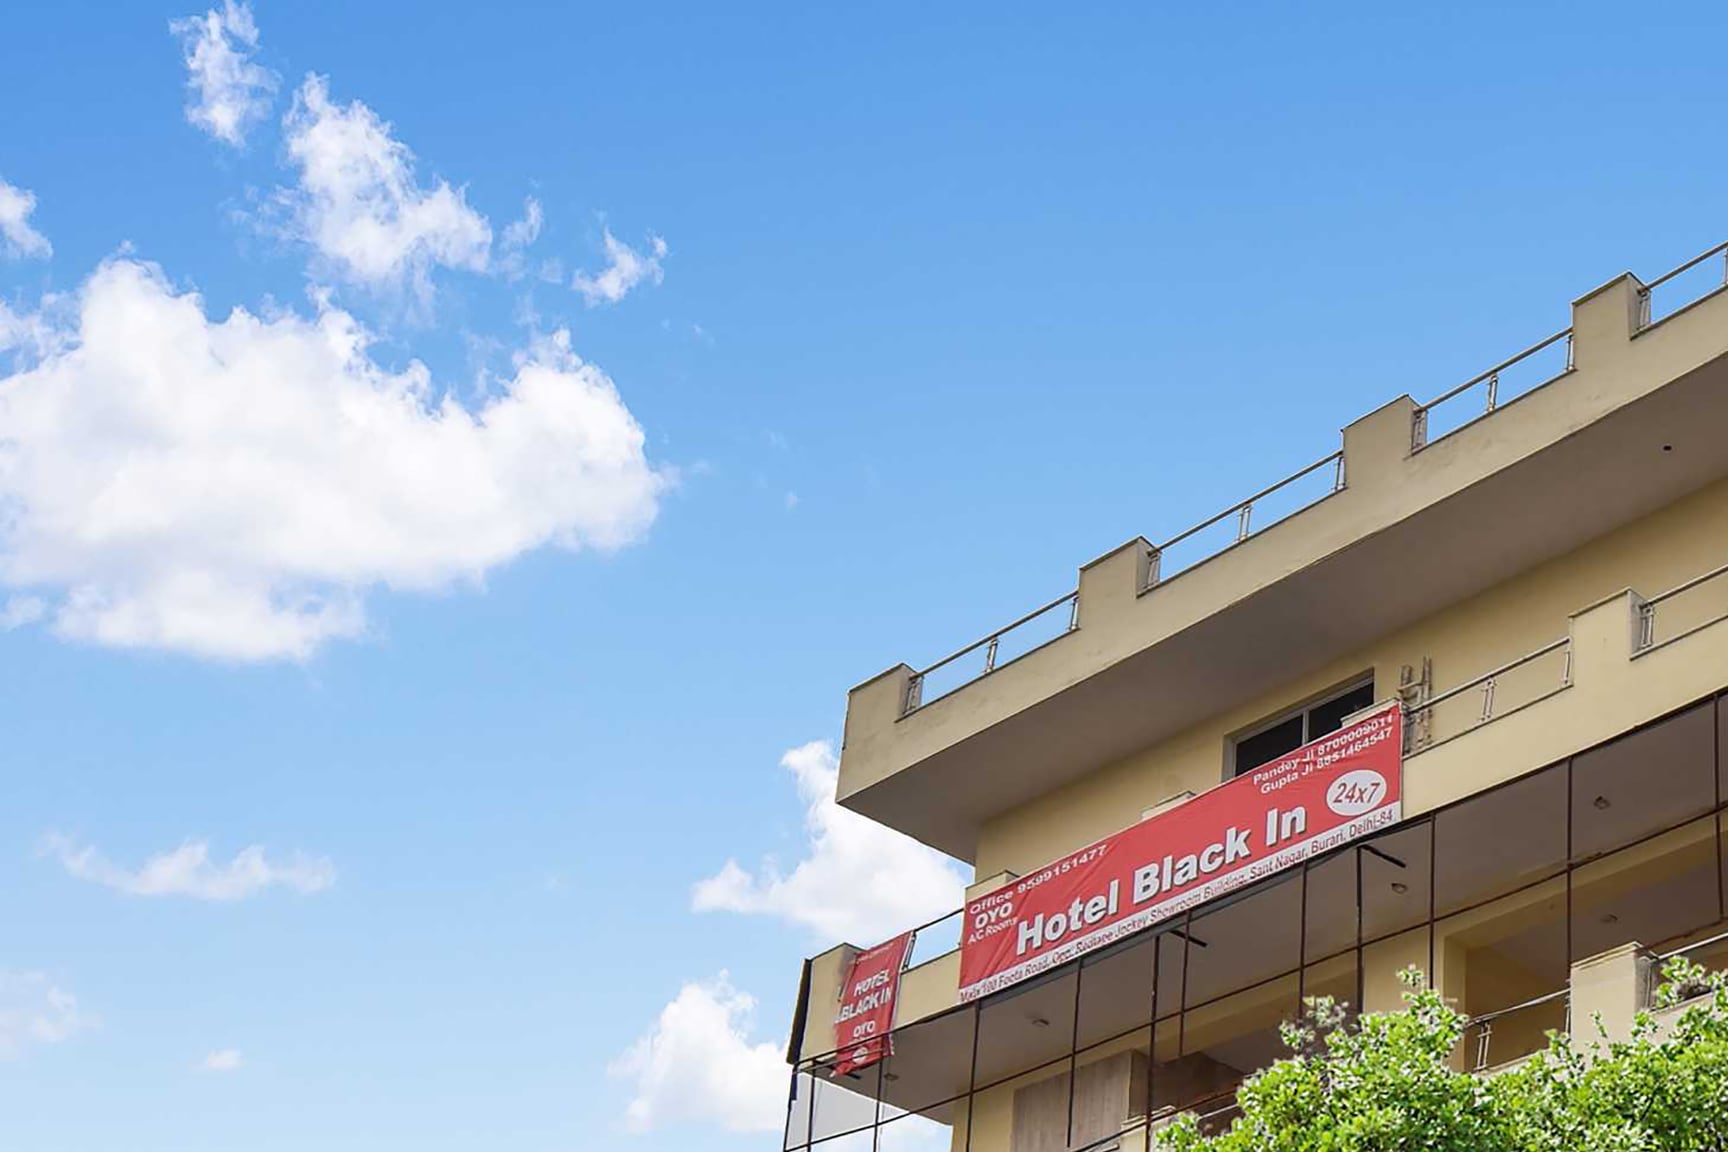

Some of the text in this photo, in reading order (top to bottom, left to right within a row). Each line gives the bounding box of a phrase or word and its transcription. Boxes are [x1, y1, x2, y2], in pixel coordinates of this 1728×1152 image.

[1261, 772, 1299, 794] Gupta
[1333, 782, 1381, 804] 24x7
[1016, 805, 1307, 956] Hotel Black In
[1250, 861, 1272, 879] Sant
[969, 890, 1013, 915] Office
[974, 902, 1013, 929] OYO
[967, 915, 1020, 945] AC Rooms
[853, 969, 890, 997] HOTEL
[841, 994, 879, 1020] BLACK
